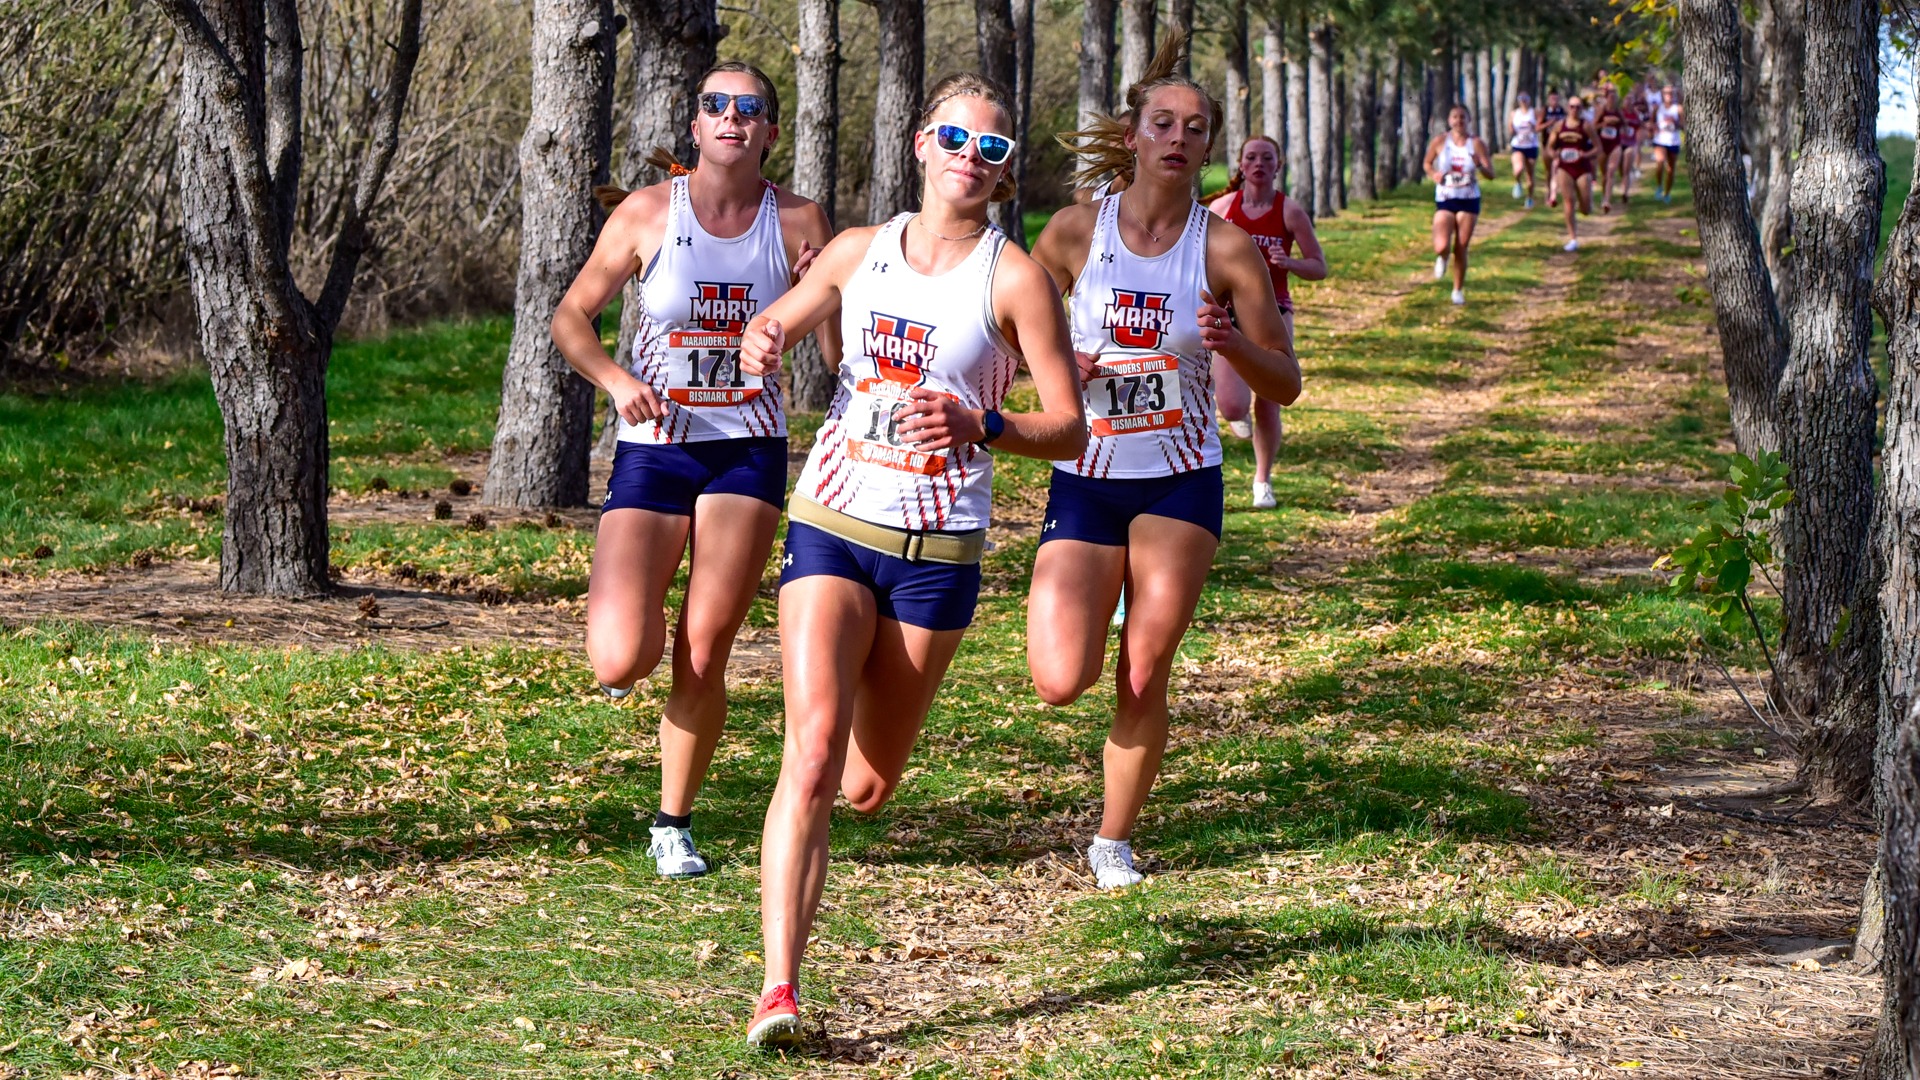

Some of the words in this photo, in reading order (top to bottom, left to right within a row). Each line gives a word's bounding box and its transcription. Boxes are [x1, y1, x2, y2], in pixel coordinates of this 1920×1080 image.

[691, 298, 756, 321] MARY
[1103, 304, 1173, 334] MARY
[1112, 288, 1171, 349] U
[682, 336, 727, 347] MARAUDERS
[863, 329, 937, 371] MARY
[870, 311, 937, 387] U
[687, 349, 745, 388] 171
[1099, 362, 1142, 376] MARAUDERS
[1143, 359, 1167, 372] INVITE
[689, 391, 729, 403] BISMARK,
[731, 391, 744, 402] ND
[1105, 373, 1166, 416] 173
[1111, 417, 1151, 431] BISMARK,
[1152, 413, 1165, 425] ND
[909, 453, 925, 469] ND
